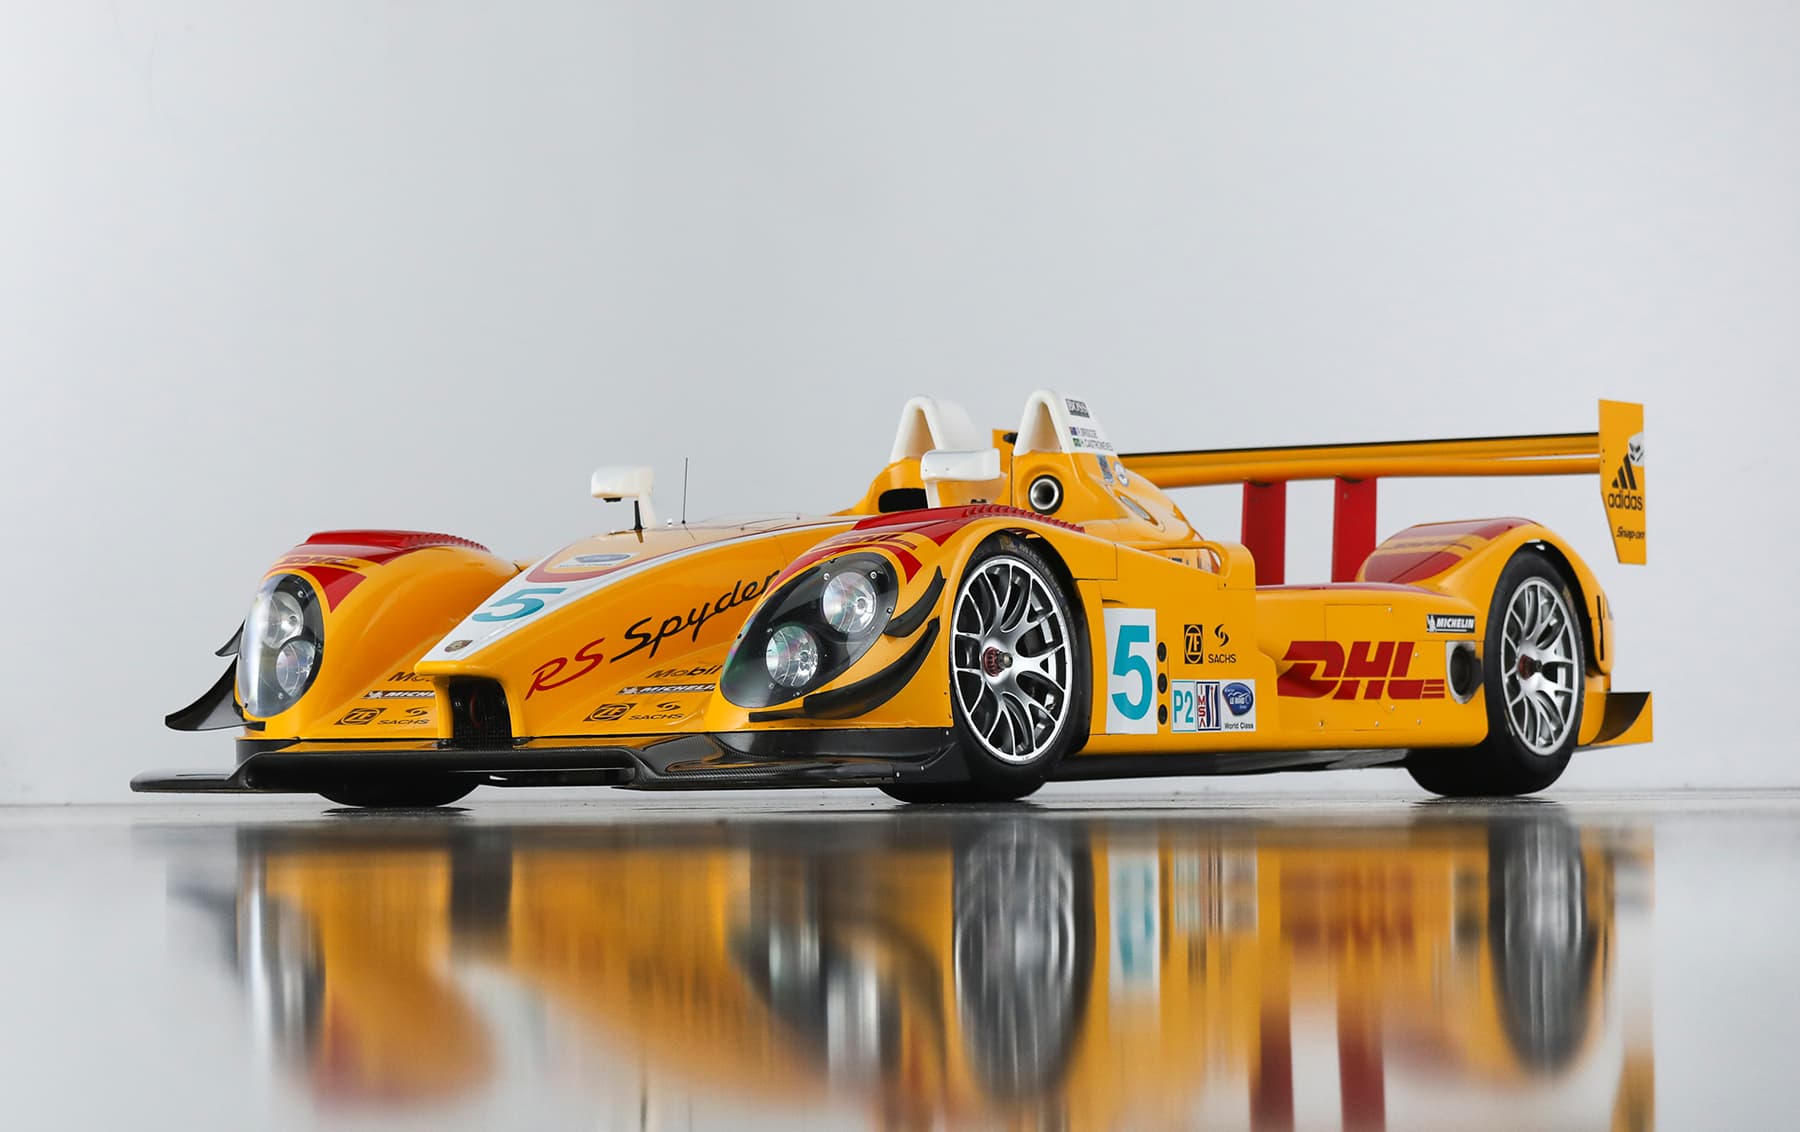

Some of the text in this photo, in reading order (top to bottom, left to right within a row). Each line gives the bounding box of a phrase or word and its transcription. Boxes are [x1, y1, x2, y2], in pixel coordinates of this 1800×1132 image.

[1608, 490, 1643, 511] adidas
[471, 587, 567, 622] 5
[525, 569, 781, 701] RS Spyder
[1435, 616, 1475, 630] MICHELIN
[647, 664, 722, 679] Mobil
[1111, 624, 1153, 720] 5
[1208, 653, 1237, 664] SACHS
[1278, 641, 1426, 700] DHL
[628, 713, 685, 721] SACHS
[1173, 689, 1194, 724] P2
